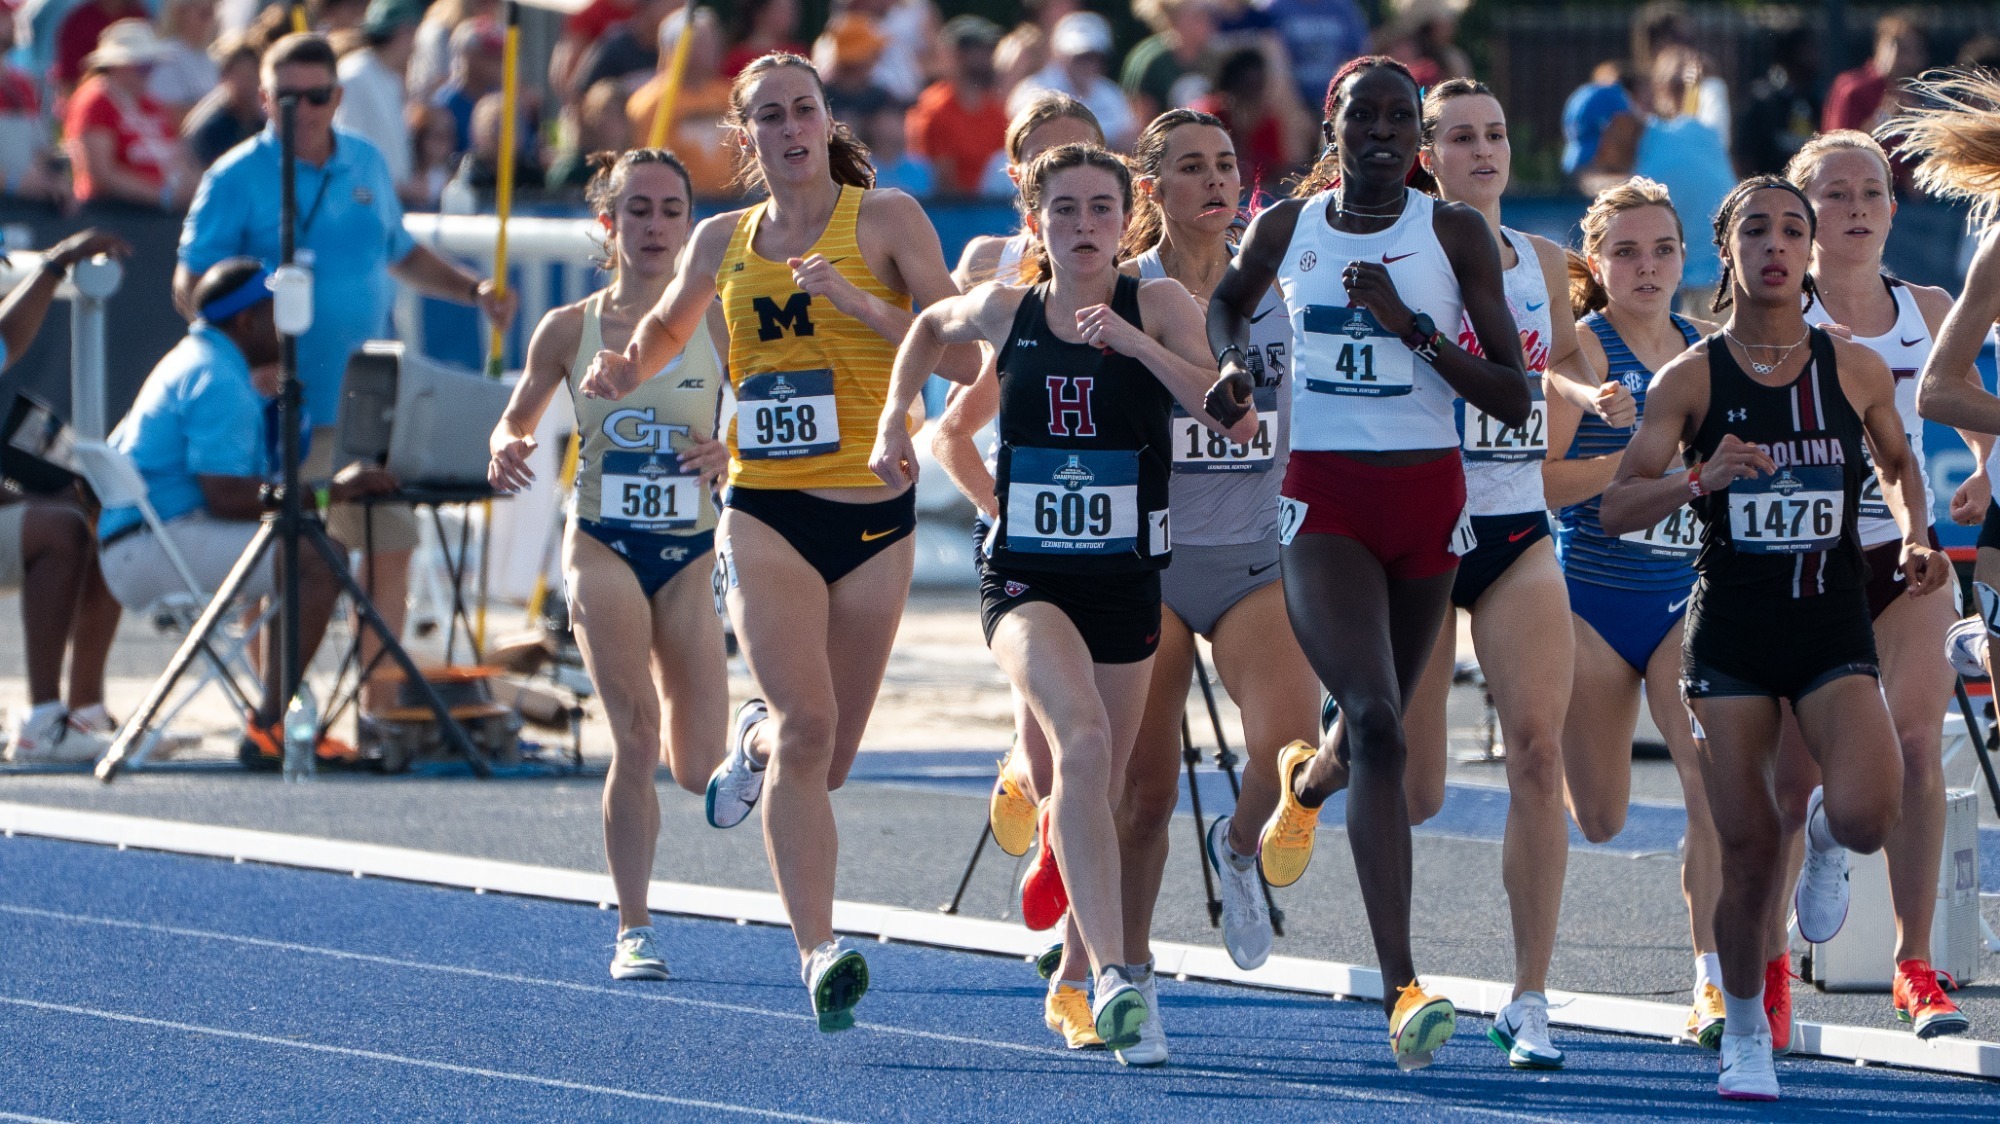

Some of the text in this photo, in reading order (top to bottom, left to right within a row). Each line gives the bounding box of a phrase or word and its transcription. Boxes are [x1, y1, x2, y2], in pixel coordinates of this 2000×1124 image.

[1301, 254, 1316, 269] SEC
[752, 292, 815, 342] M
[1017, 338, 1031, 348] Ivy
[1335, 343, 1377, 381] 41
[677, 379, 704, 389] ACC
[1623, 372, 1643, 391] SEC
[756, 404, 818, 445] 958
[1046, 375, 1096, 437] H
[602, 407, 690, 454] GT
[1476, 408, 1544, 448] 1242
[622, 483, 678, 518] 581
[1035, 491, 1112, 537] 609
[1743, 498, 1833, 538] 1476
[660, 546, 688, 562] GT
[1041, 541, 1106, 549] LEXINGTON, KENTUCKY
